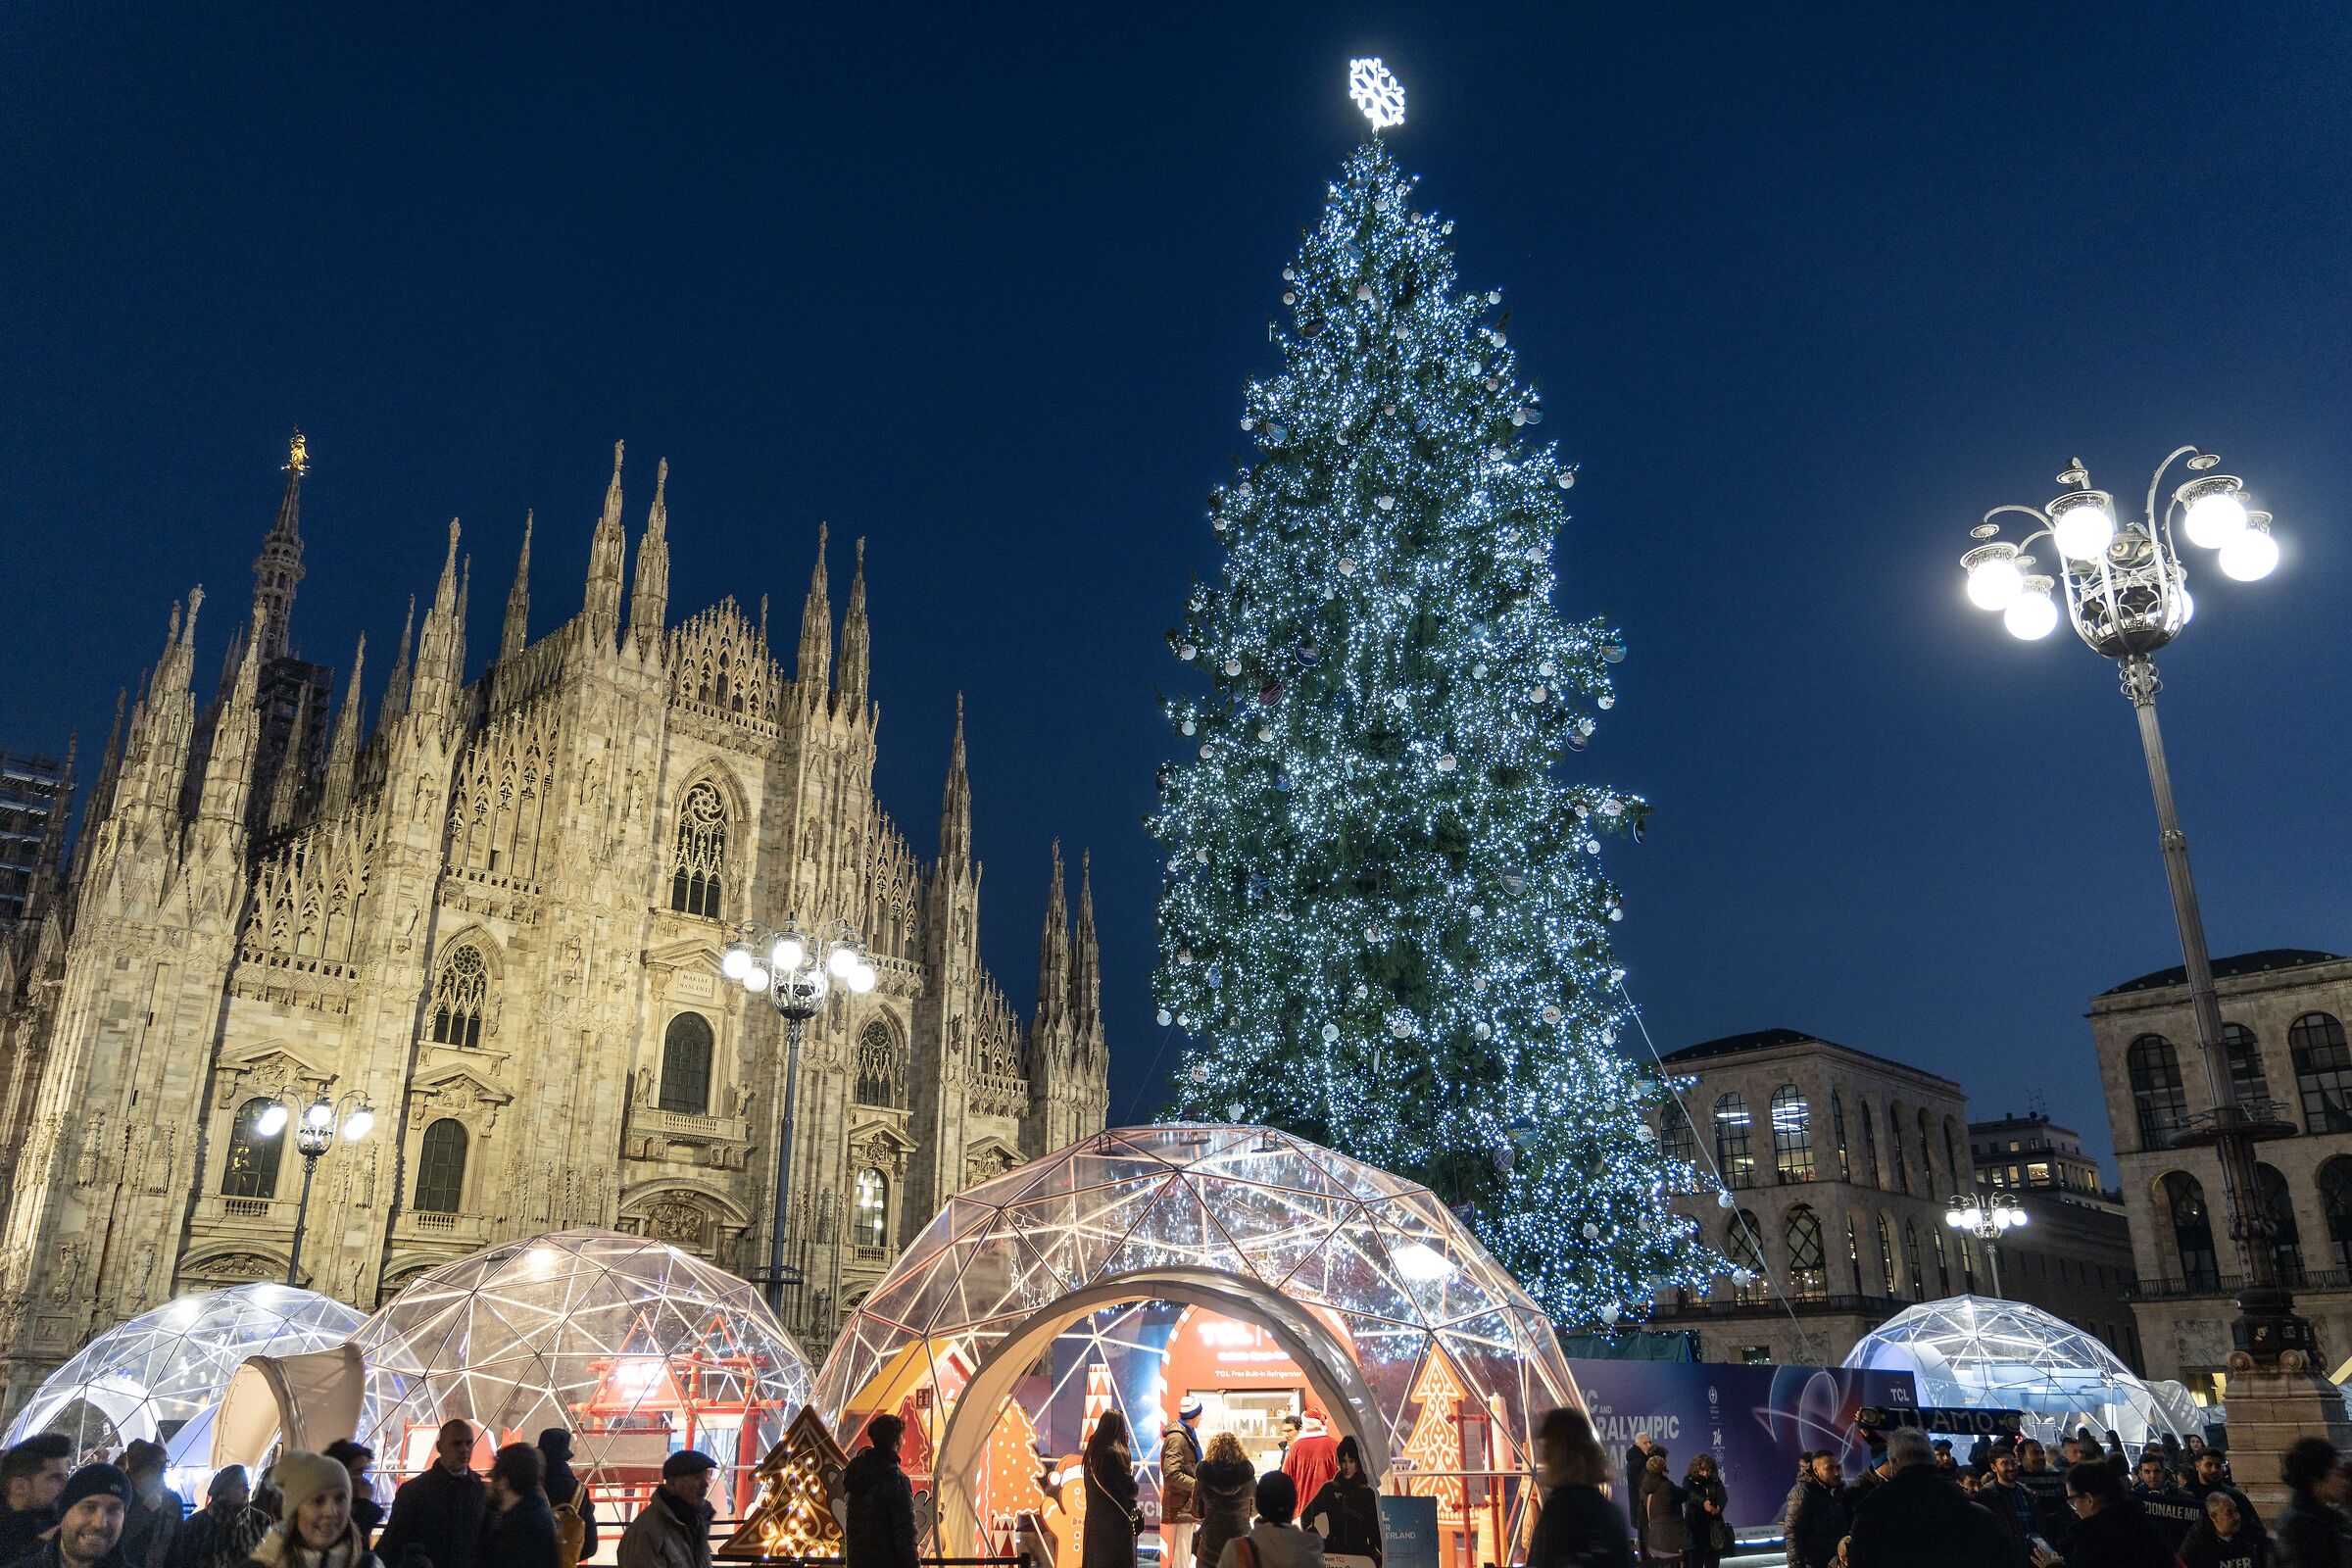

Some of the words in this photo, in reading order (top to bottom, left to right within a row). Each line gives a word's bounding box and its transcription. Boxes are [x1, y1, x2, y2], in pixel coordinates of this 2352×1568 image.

[1890, 1388, 1910, 1401] TCL
[1599, 1405, 1612, 1414] AND
[1595, 1415, 1680, 1441] RALYMPIC
[1931, 1410, 1994, 1434] AMO
[2143, 1500, 2184, 1519] ZIONALE
[1385, 1531, 1416, 1540] ERLAND
